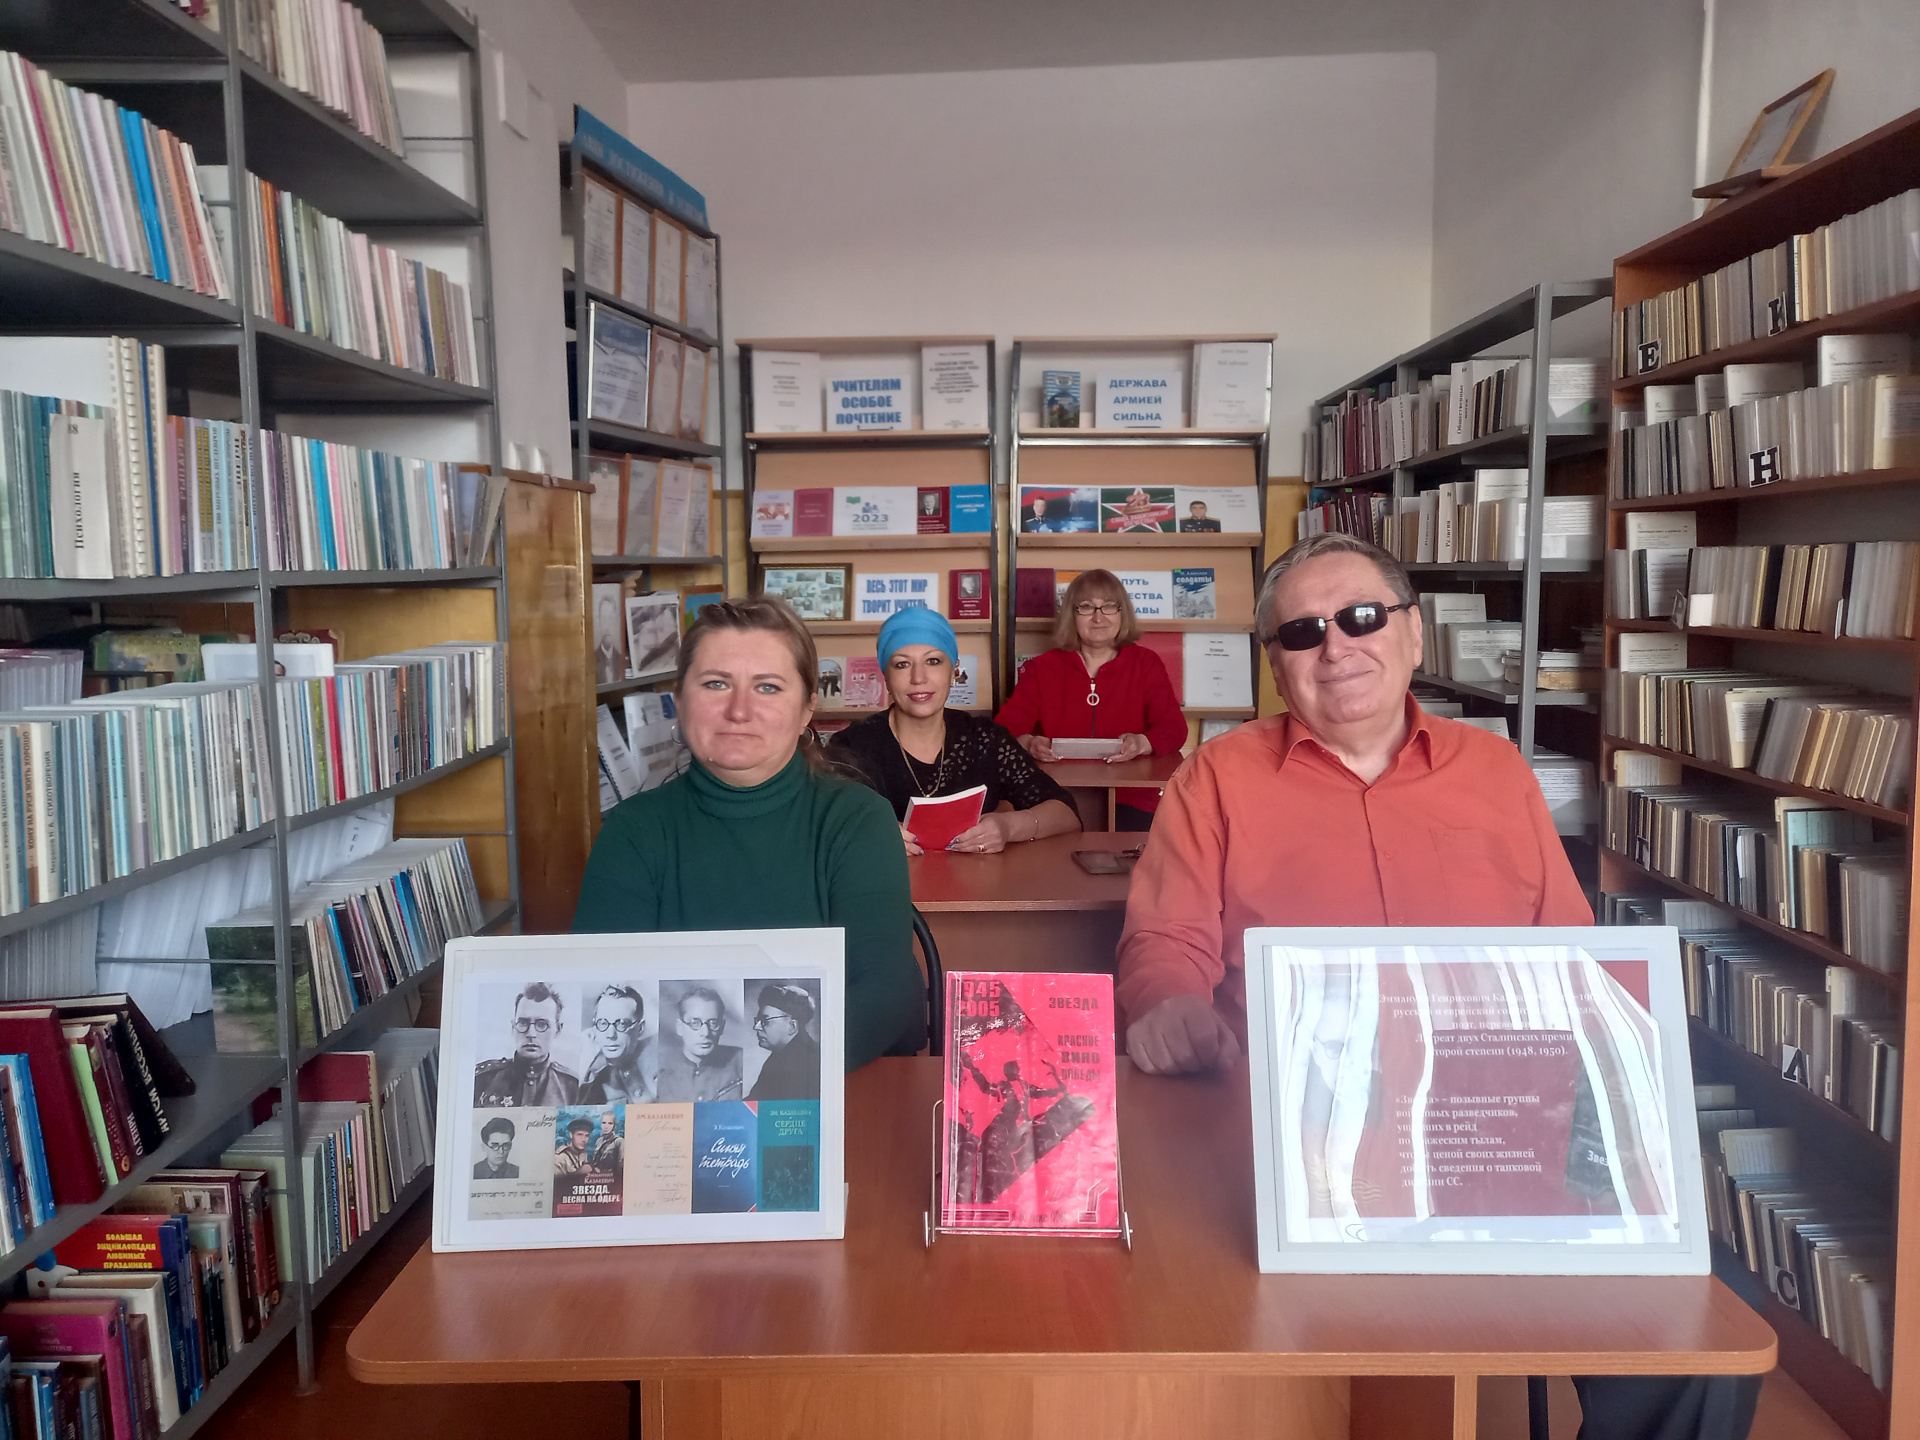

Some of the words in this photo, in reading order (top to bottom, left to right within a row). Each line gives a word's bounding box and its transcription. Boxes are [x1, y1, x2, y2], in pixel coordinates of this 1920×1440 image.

[1639, 342, 1660, 373] Е
[832, 378, 902, 393] УЧИТЕЛЯМ
[1109, 379, 1168, 389] ДЕРЖАВА
[841, 396, 893, 409] ОСОБОЕ
[1113, 395, 1163, 405] АРМИЕЙ
[836, 411, 902, 425] ПОЧТЕНИЕ
[1112, 412, 1162, 421] СИЛЬНА
[1750, 446, 1780, 487] Н
[72, 472, 84, 549] Психология
[852, 513, 889, 523] 2023
[866, 578, 887, 594] ВЕСЬ
[889, 578, 908, 593] ЭТОТ
[910, 578, 928, 593] МИР
[1121, 578, 1149, 586] ПУТЬ
[1127, 592, 1163, 600] ЕСТВА
[862, 599, 891, 614] ТВОРИТ
[1135, 606, 1160, 614] АВЫ
[22, 731, 31, 766] ХОРОШО
[23, 767, 32, 790] ЖИТЬ
[46, 751, 54, 817] СТИХОТВОРЕНИЯ
[24, 792, 33, 813] РУСИ
[25, 814, 34, 826] НА
[26, 827, 35, 849] КОМУ
[956, 1000, 1000, 1017] 2005
[1048, 997, 1098, 1011] ЗВЕЗДА
[1057, 1034, 1100, 1047] КРАСНОЕ
[1457, 1034, 1479, 1044] двух
[1481, 1032, 1539, 1043] Сталинских
[1433, 1045, 1464, 1056] торой
[1465, 1047, 1505, 1056] степени
[1061, 1051, 1100, 1064] ВИНО
[1061, 1068, 1100, 1081] ПОБЕДЫ
[1450, 1095, 1501, 1104] позывные
[1503, 1095, 1541, 1107] группы
[1452, 1108, 1519, 1120] разведчиков,
[774, 1119, 807, 1129] СЕРДЦЕ
[1453, 1121, 1478, 1134] рейд
[778, 1127, 804, 1137] ДРУГА
[710, 1137, 747, 1158] Синяя
[1432, 1148, 1464, 1160] ценой
[1465, 1151, 1495, 1159] своих
[1496, 1148, 1535, 1159] жизней
[1438, 1164, 1485, 1174] сведения
[1494, 1162, 1542, 1173] танковой
[1446, 1176, 1464, 1187] СС.
[572, 1185, 611, 1195] ЗВЕЗДА.
[562, 1196, 586, 1204] ВЕСНА
[587, 1195, 597, 1203] НА
[598, 1194, 621, 1204] ОДЕРЕ
[106, 1233, 143, 1241] БОЛЬШАЯ
[97, 1242, 156, 1251] ЭНЦИКЛОПЕДИЯ
[106, 1252, 146, 1260] ЛЮБИМЫХ
[103, 1261, 153, 1269] ПРАЗДНИКОВ
